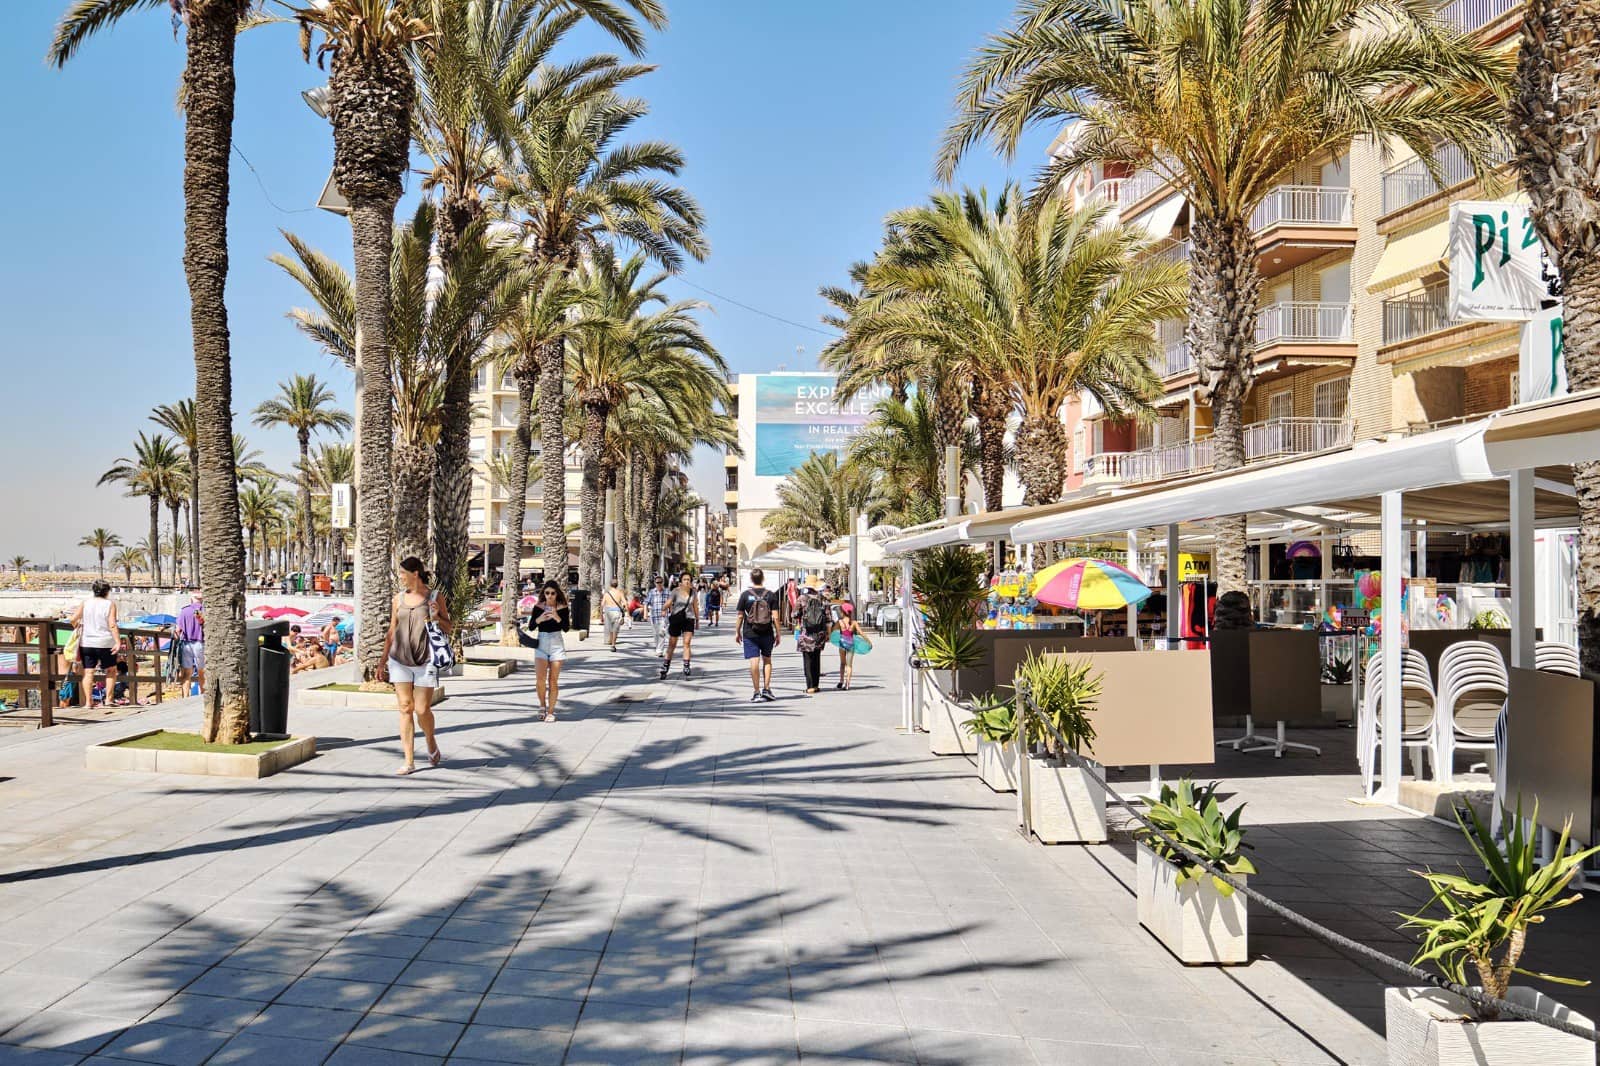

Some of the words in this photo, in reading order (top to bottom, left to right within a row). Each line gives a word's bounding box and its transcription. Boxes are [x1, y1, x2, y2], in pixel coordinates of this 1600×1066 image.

[808, 425, 820, 434] IN
[823, 425, 850, 434] REAL
[1184, 560, 1210, 571] ATM
[1342, 617, 1370, 626] SALIDA
